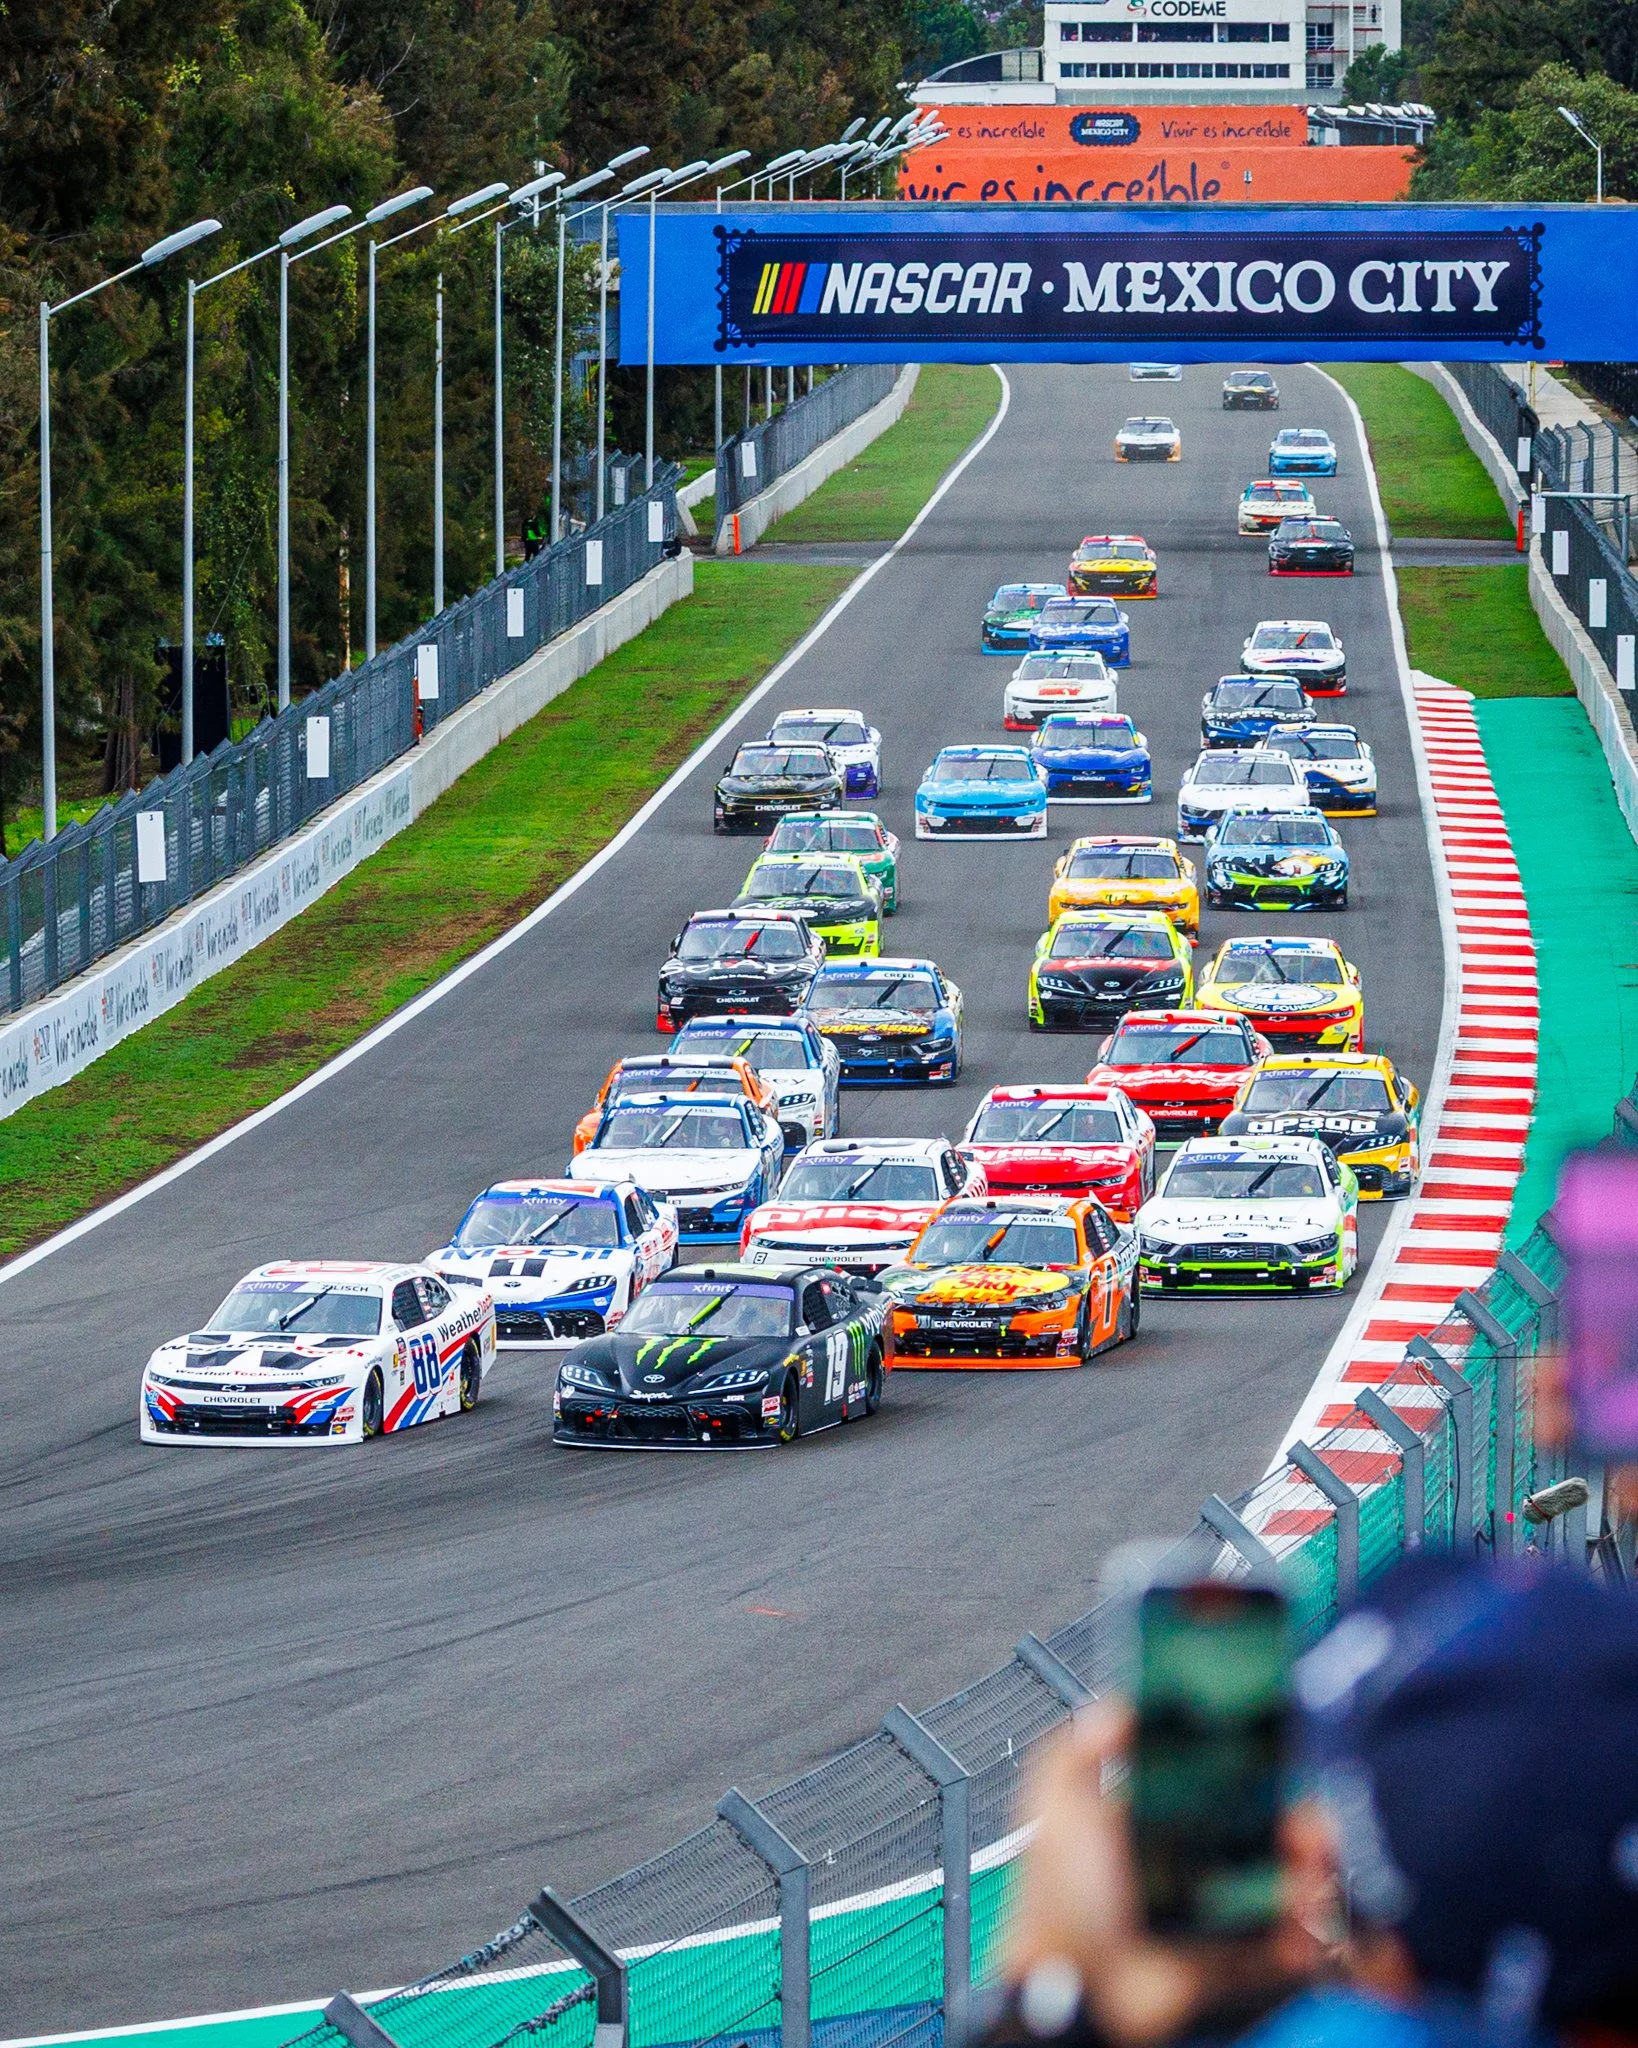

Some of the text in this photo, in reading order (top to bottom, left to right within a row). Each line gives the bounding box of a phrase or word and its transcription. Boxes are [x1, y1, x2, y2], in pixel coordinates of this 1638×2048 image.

[1151, 1, 1226, 16] CODEME
[1095, 119, 1124, 127] NASCAR
[957, 126, 972, 138] es
[976, 119, 1048, 138] increíble
[1161, 119, 1292, 138] Vivir es increíble
[981, 179, 1015, 201] es
[821, 259, 1510, 315] NASCAR MEXICO CITY
[695, 922, 729, 930] xfinity
[1066, 922, 1101, 931] xfinity
[826, 971, 862, 980] xfinity
[1128, 1023, 1168, 1032] xfinity
[688, 1030, 728, 1039] xfinity
[623, 1068, 663, 1078] xfinity
[1264, 1069, 1306, 1078] xfinity
[991, 1099, 1034, 1109] xfinity
[617, 1106, 660, 1116] xfinity
[1149, 1109, 1199, 1117] CHEVROLET
[804, 1155, 849, 1166] xfinity
[1187, 1152, 1231, 1162] xfinity
[521, 1196, 568, 1207] xfinity
[939, 1214, 985, 1224] xfinity
[1150, 1214, 1325, 1228] AUDIBEL
[441, 1248, 614, 1261] Mobil
[753, 1251, 768, 1265] 8
[245, 1281, 292, 1292] xfinity
[691, 1283, 740, 1293] xfinity
[951, 1279, 1042, 1296] Shops
[934, 1320, 993, 1328] CHEVROLET
[408, 1332, 442, 1396] 88
[823, 1328, 849, 1407] 19
[175, 1368, 305, 1377] WeatherTech.com
[203, 1395, 262, 1405] CHEVROLET
[629, 1389, 673, 1402] Supra
